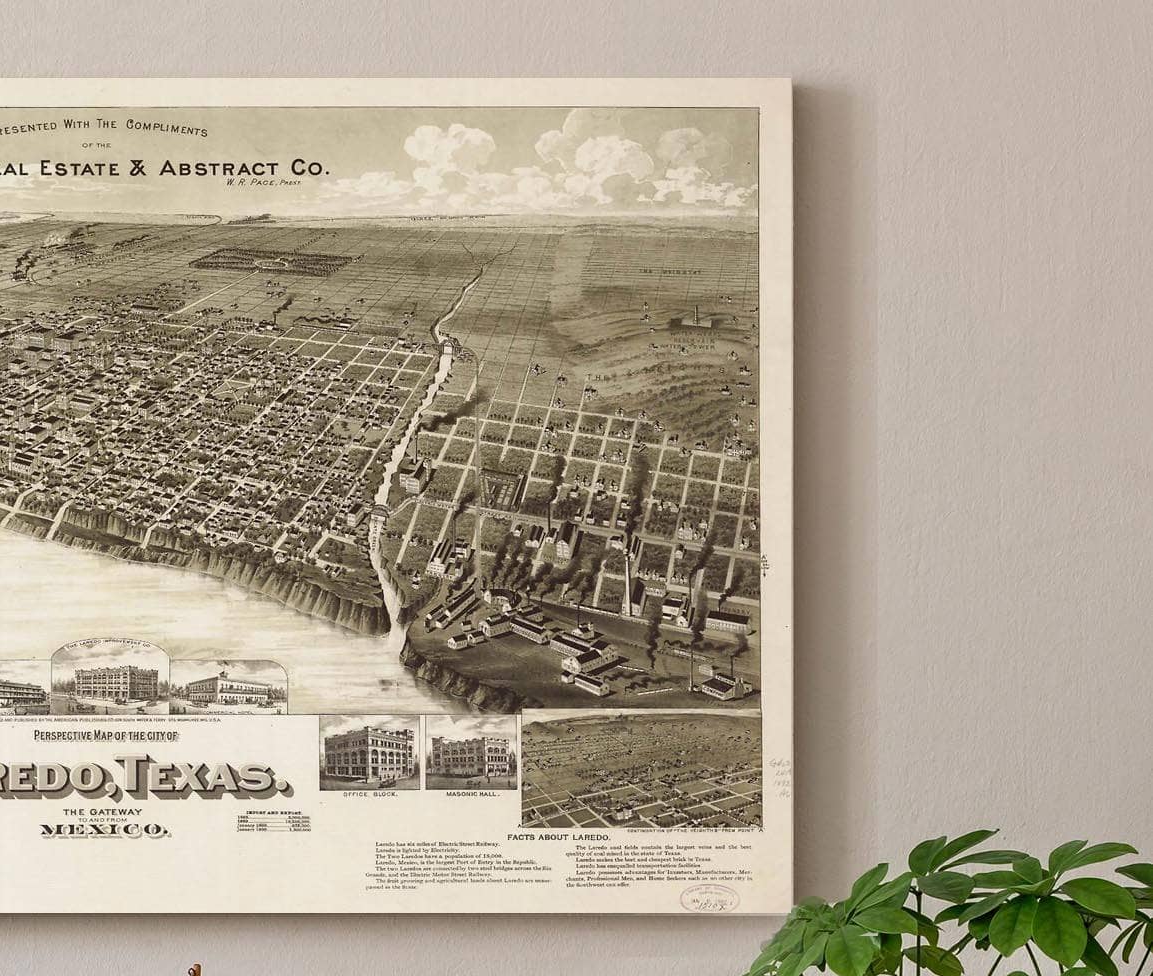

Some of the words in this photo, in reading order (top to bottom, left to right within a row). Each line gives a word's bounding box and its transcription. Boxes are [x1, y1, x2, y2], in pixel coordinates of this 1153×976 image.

[64, 119, 90, 129] WITH
[96, 119, 117, 128] THE
[126, 118, 208, 137] COMPLIMENTS
[40, 160, 120, 176] ESTATE
[130, 160, 146, 176] &
[160, 160, 279, 176] ABSTRACT
[292, 160, 330, 176] CO.
[34, 730, 92, 742] PERSPECTIVE
[94, 730, 113, 742] MAP
[115, 730, 126, 742] OF
[128, 730, 145, 742] THE
[147, 730, 166, 742] CITY
[167, 730, 179, 742] OF
[115, 753, 294, 800] TEXAS.
[40, 824, 172, 839] MEXICO.
